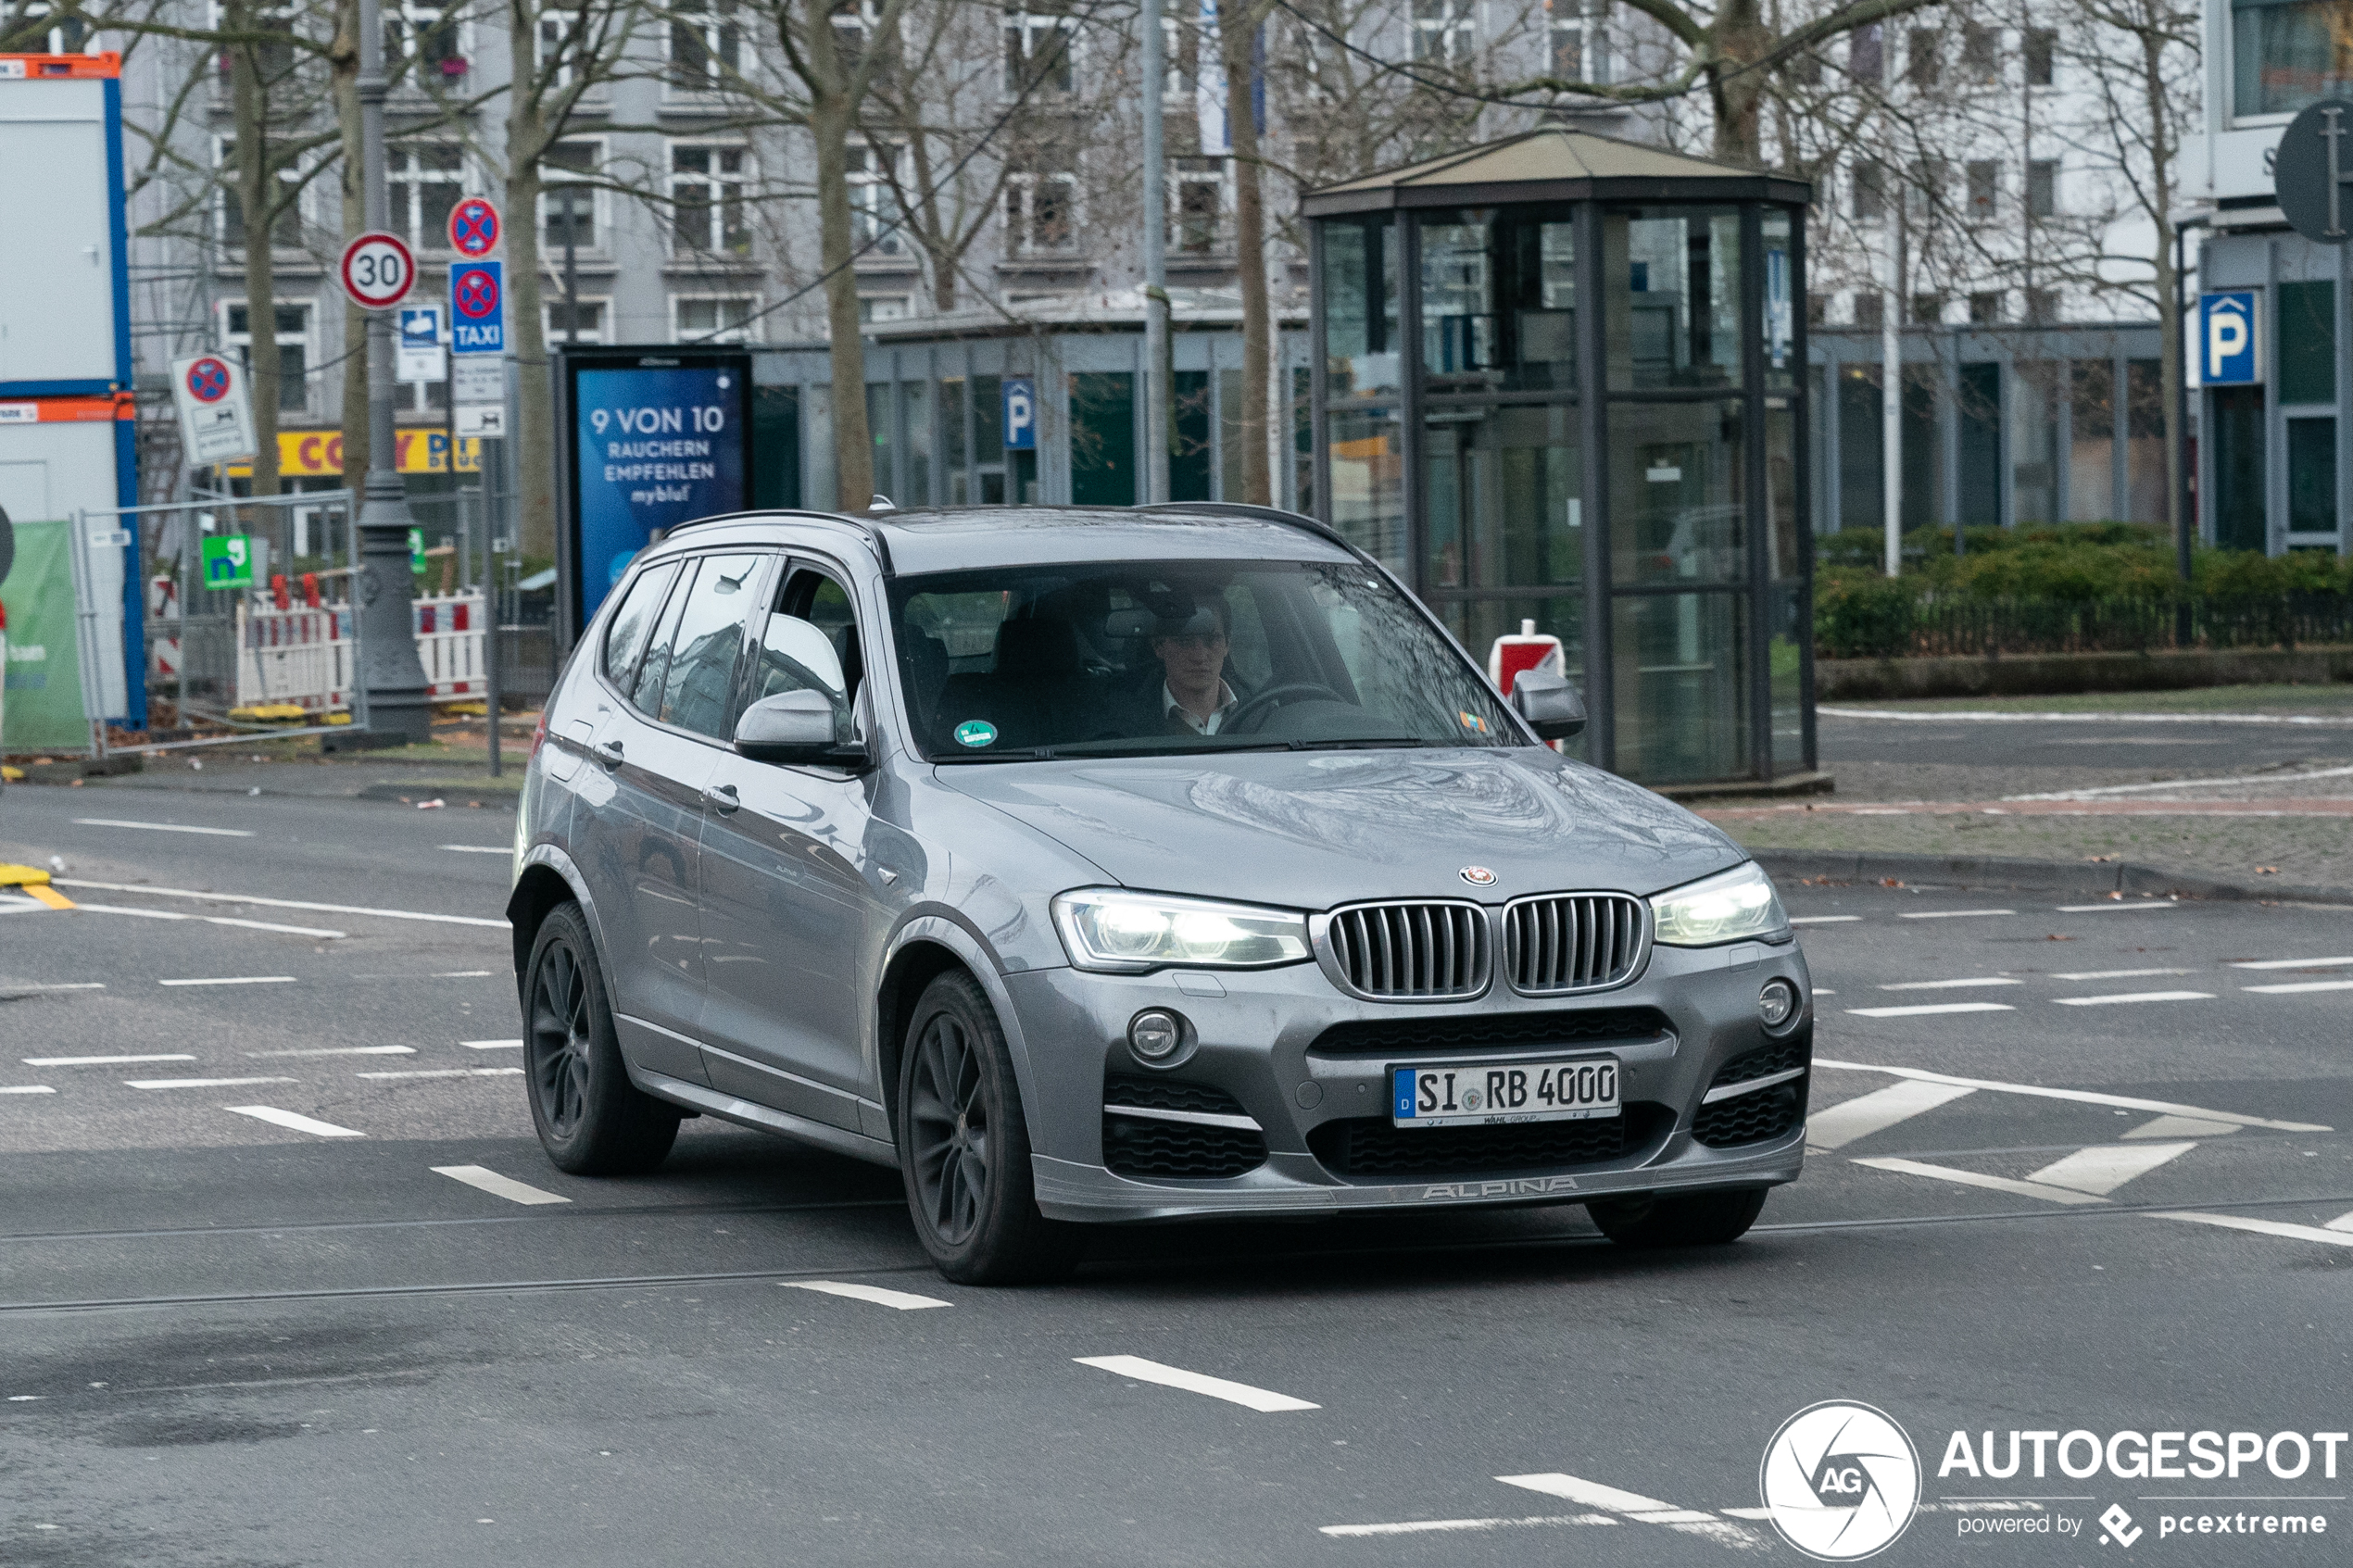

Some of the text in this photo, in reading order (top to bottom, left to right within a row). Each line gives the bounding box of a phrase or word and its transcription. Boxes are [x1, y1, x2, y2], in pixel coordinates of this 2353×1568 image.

[358, 255, 398, 286] 30
[455, 324, 500, 345] TAXI
[2209, 312, 2248, 378] P
[590, 405, 725, 434] 9 VON 10
[1009, 395, 1031, 444] P
[607, 440, 711, 458] RAUCHERN
[604, 462, 715, 482] EMPFEHLEN
[1417, 1065, 1615, 1111] SI RB 4000
[1401, 1099, 1409, 1110] D
[1422, 1176, 1579, 1199] ALPINA
